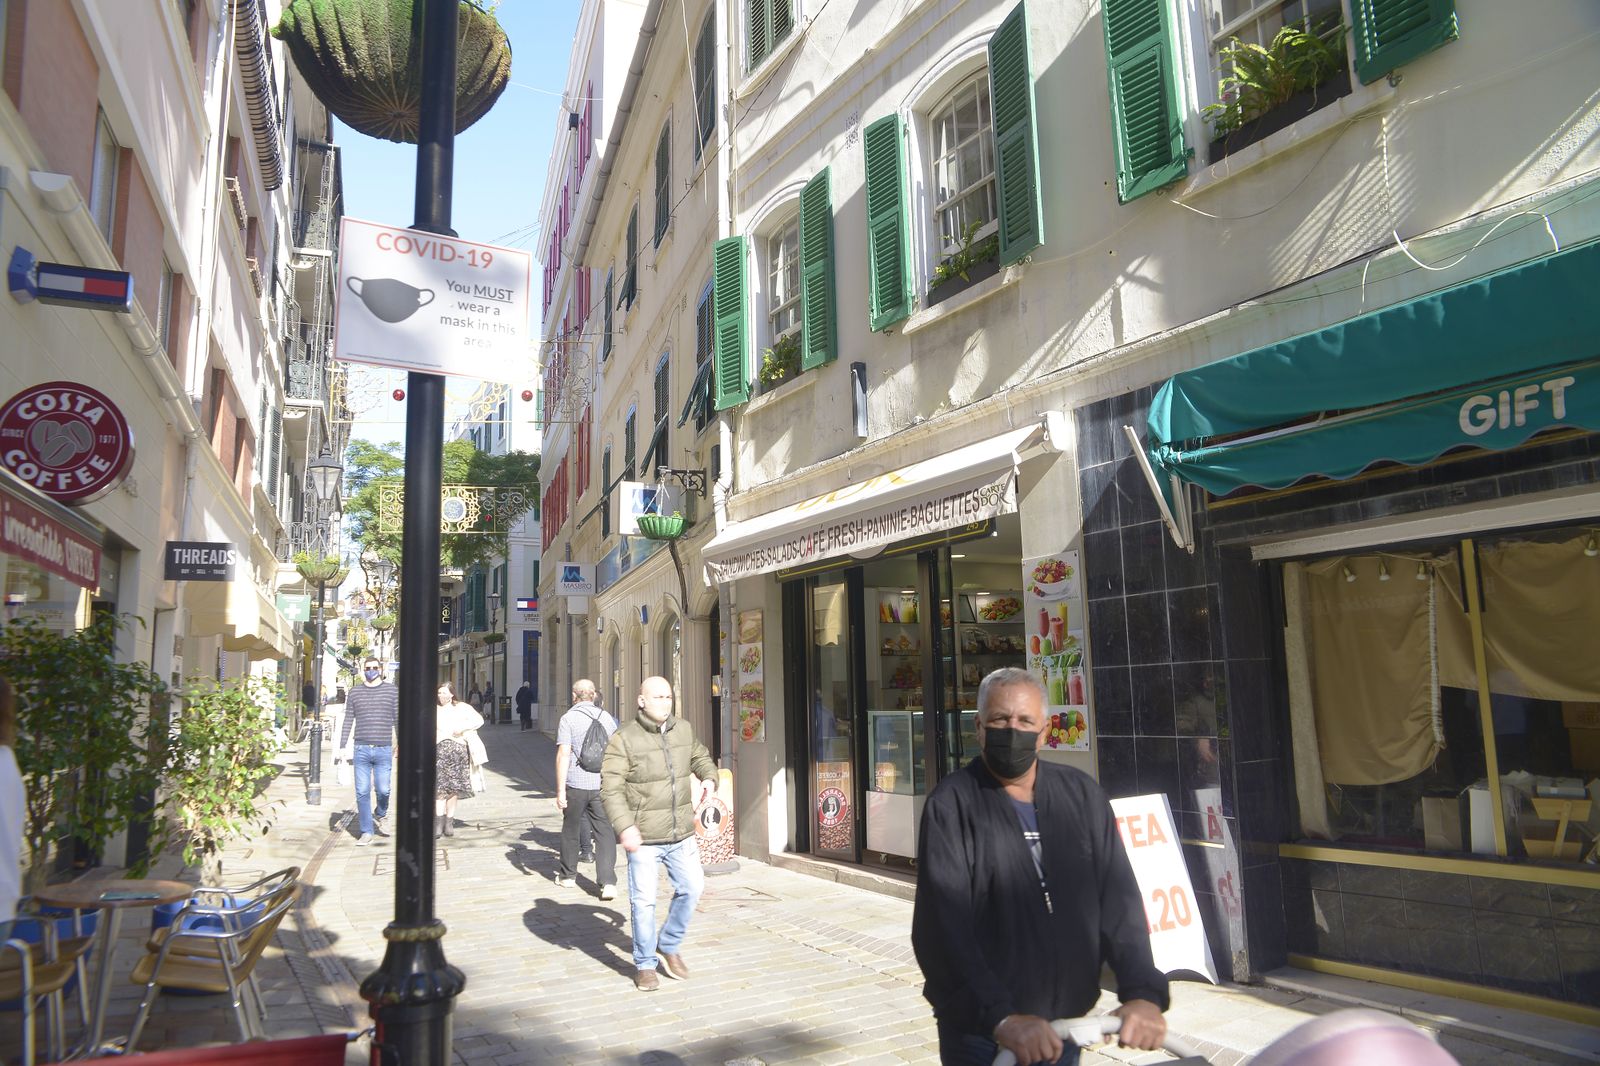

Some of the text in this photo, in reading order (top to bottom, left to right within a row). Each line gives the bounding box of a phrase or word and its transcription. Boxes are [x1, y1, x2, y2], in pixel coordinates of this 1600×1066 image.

[376, 232, 494, 269] COVID-19
[446, 279, 514, 302] You MUST
[457, 301, 501, 316] wear a
[440, 314, 516, 336] mask in this
[17, 392, 105, 425] COSTA
[1459, 376, 1575, 437] GIFT
[99, 434, 116, 444] 1971
[5, 449, 111, 490] COFFEE
[980, 483, 1006, 497] CARTE
[173, 548, 236, 566] THREADS
[1147, 885, 1192, 935] .20
